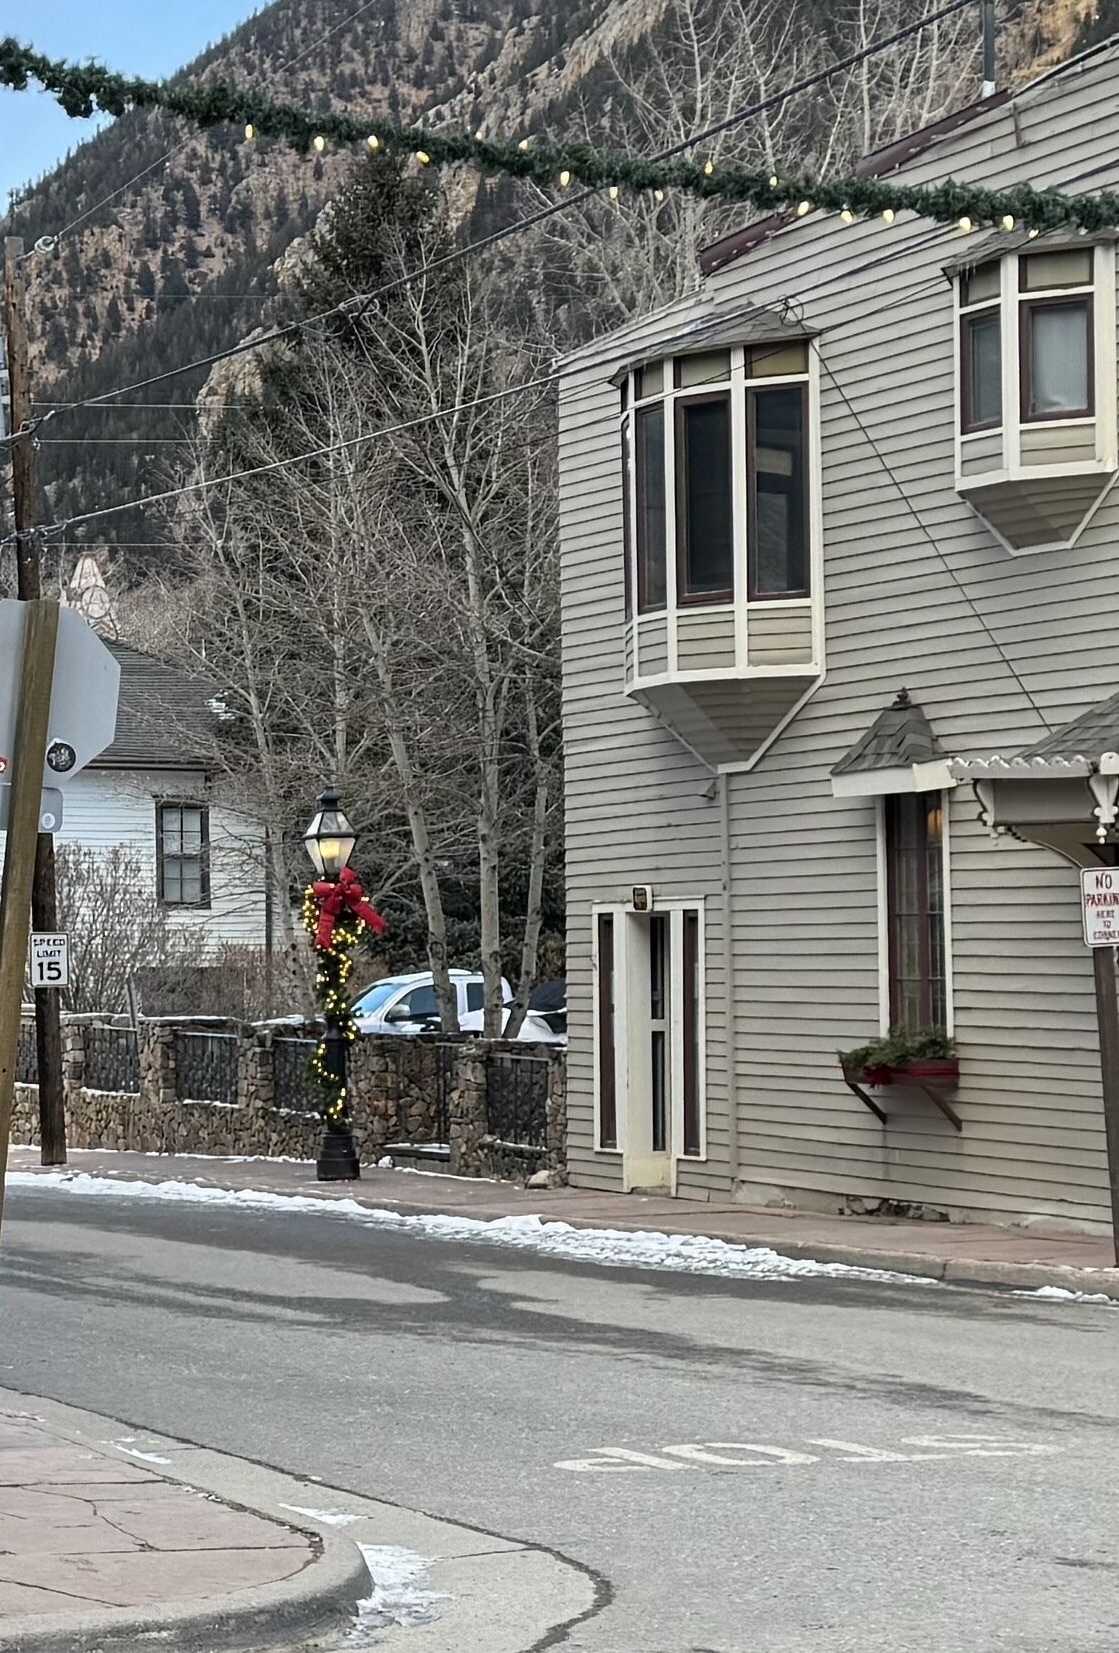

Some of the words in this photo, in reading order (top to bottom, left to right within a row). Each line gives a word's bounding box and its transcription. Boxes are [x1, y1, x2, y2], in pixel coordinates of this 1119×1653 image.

[1095, 873, 1113, 890] NO
[1086, 893, 1119, 908] PARKIN
[1103, 920, 1112, 929] TO
[33, 938, 66, 947] SPEED
[36, 949, 62, 958] LIMIT
[37, 961, 62, 981] 15
[553, 1433, 1065, 1472] STOP
